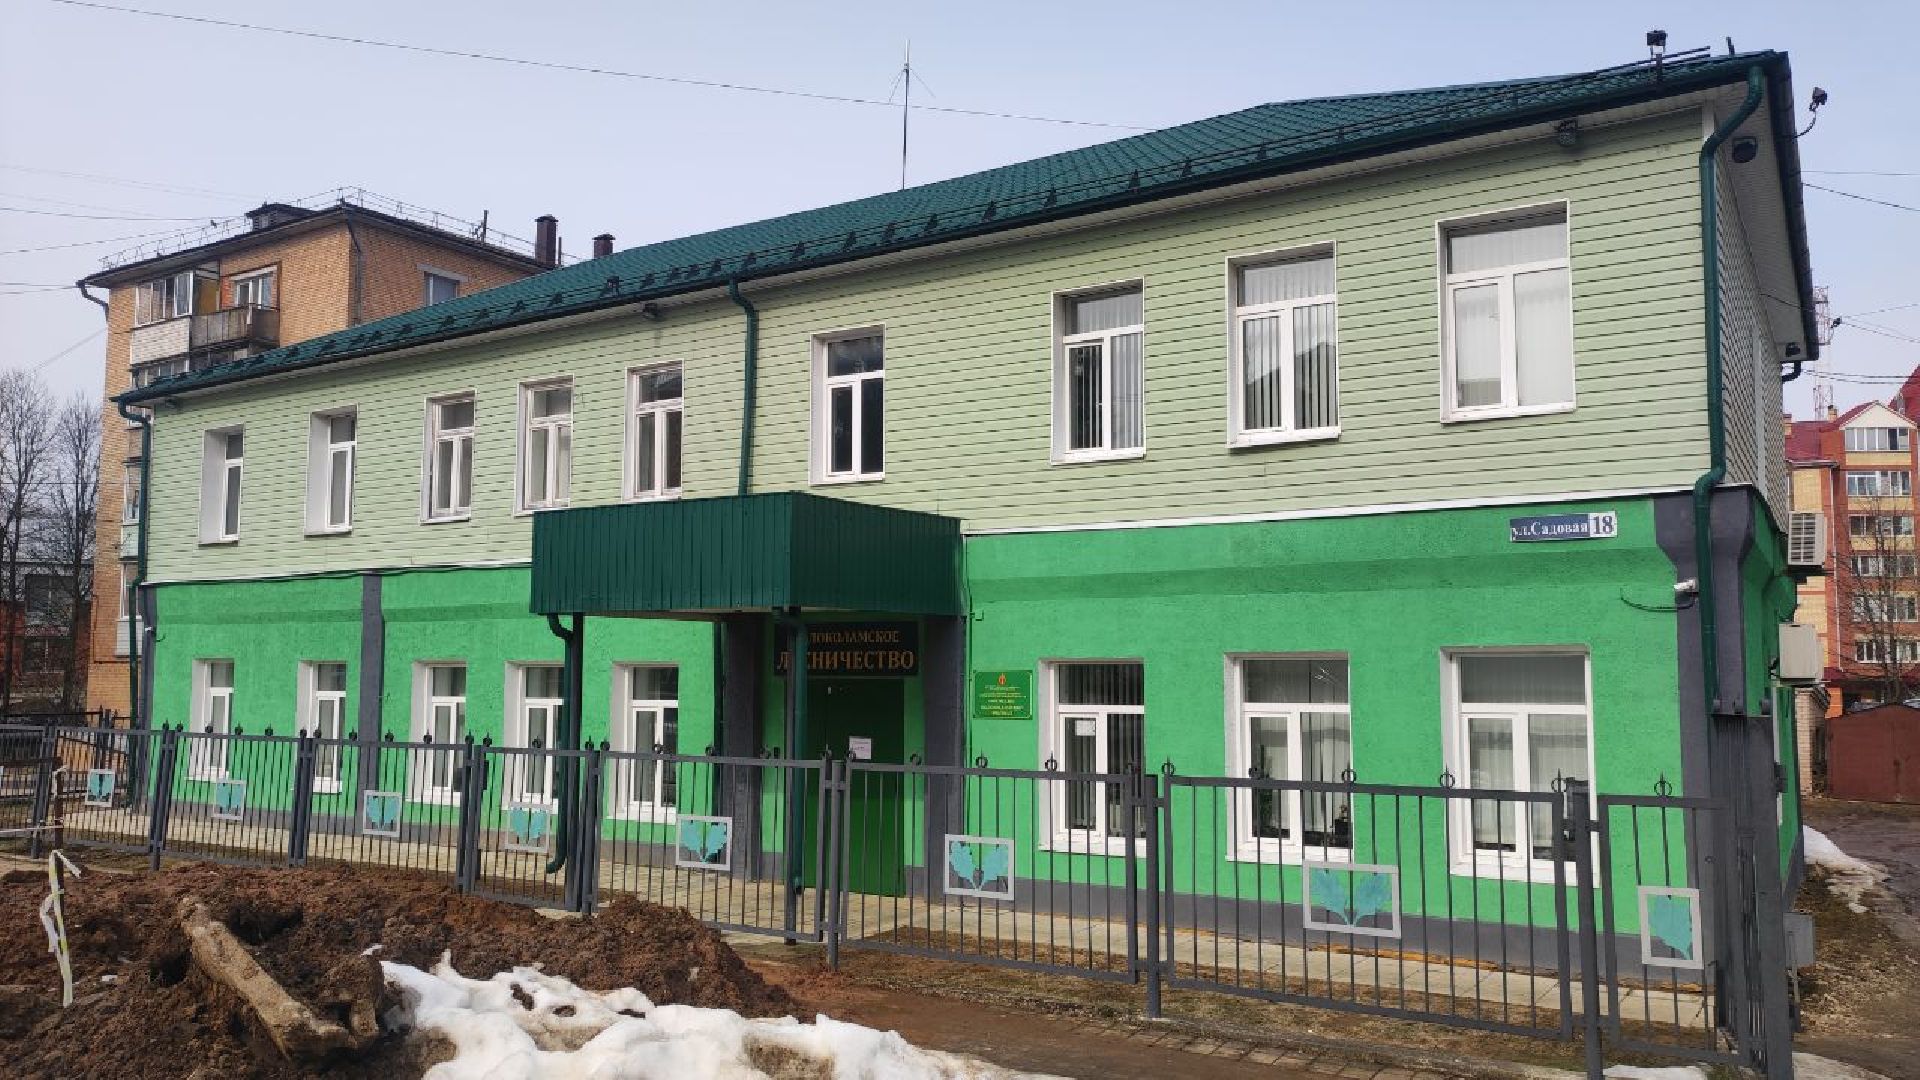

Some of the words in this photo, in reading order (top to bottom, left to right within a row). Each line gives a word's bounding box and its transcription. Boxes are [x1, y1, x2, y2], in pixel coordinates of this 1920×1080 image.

[1592, 515, 1613, 535] 18
[801, 630, 900, 643] ЛОКОЛАМСКОЕ
[776, 649, 915, 670] ЛНИЧЕСТВО
